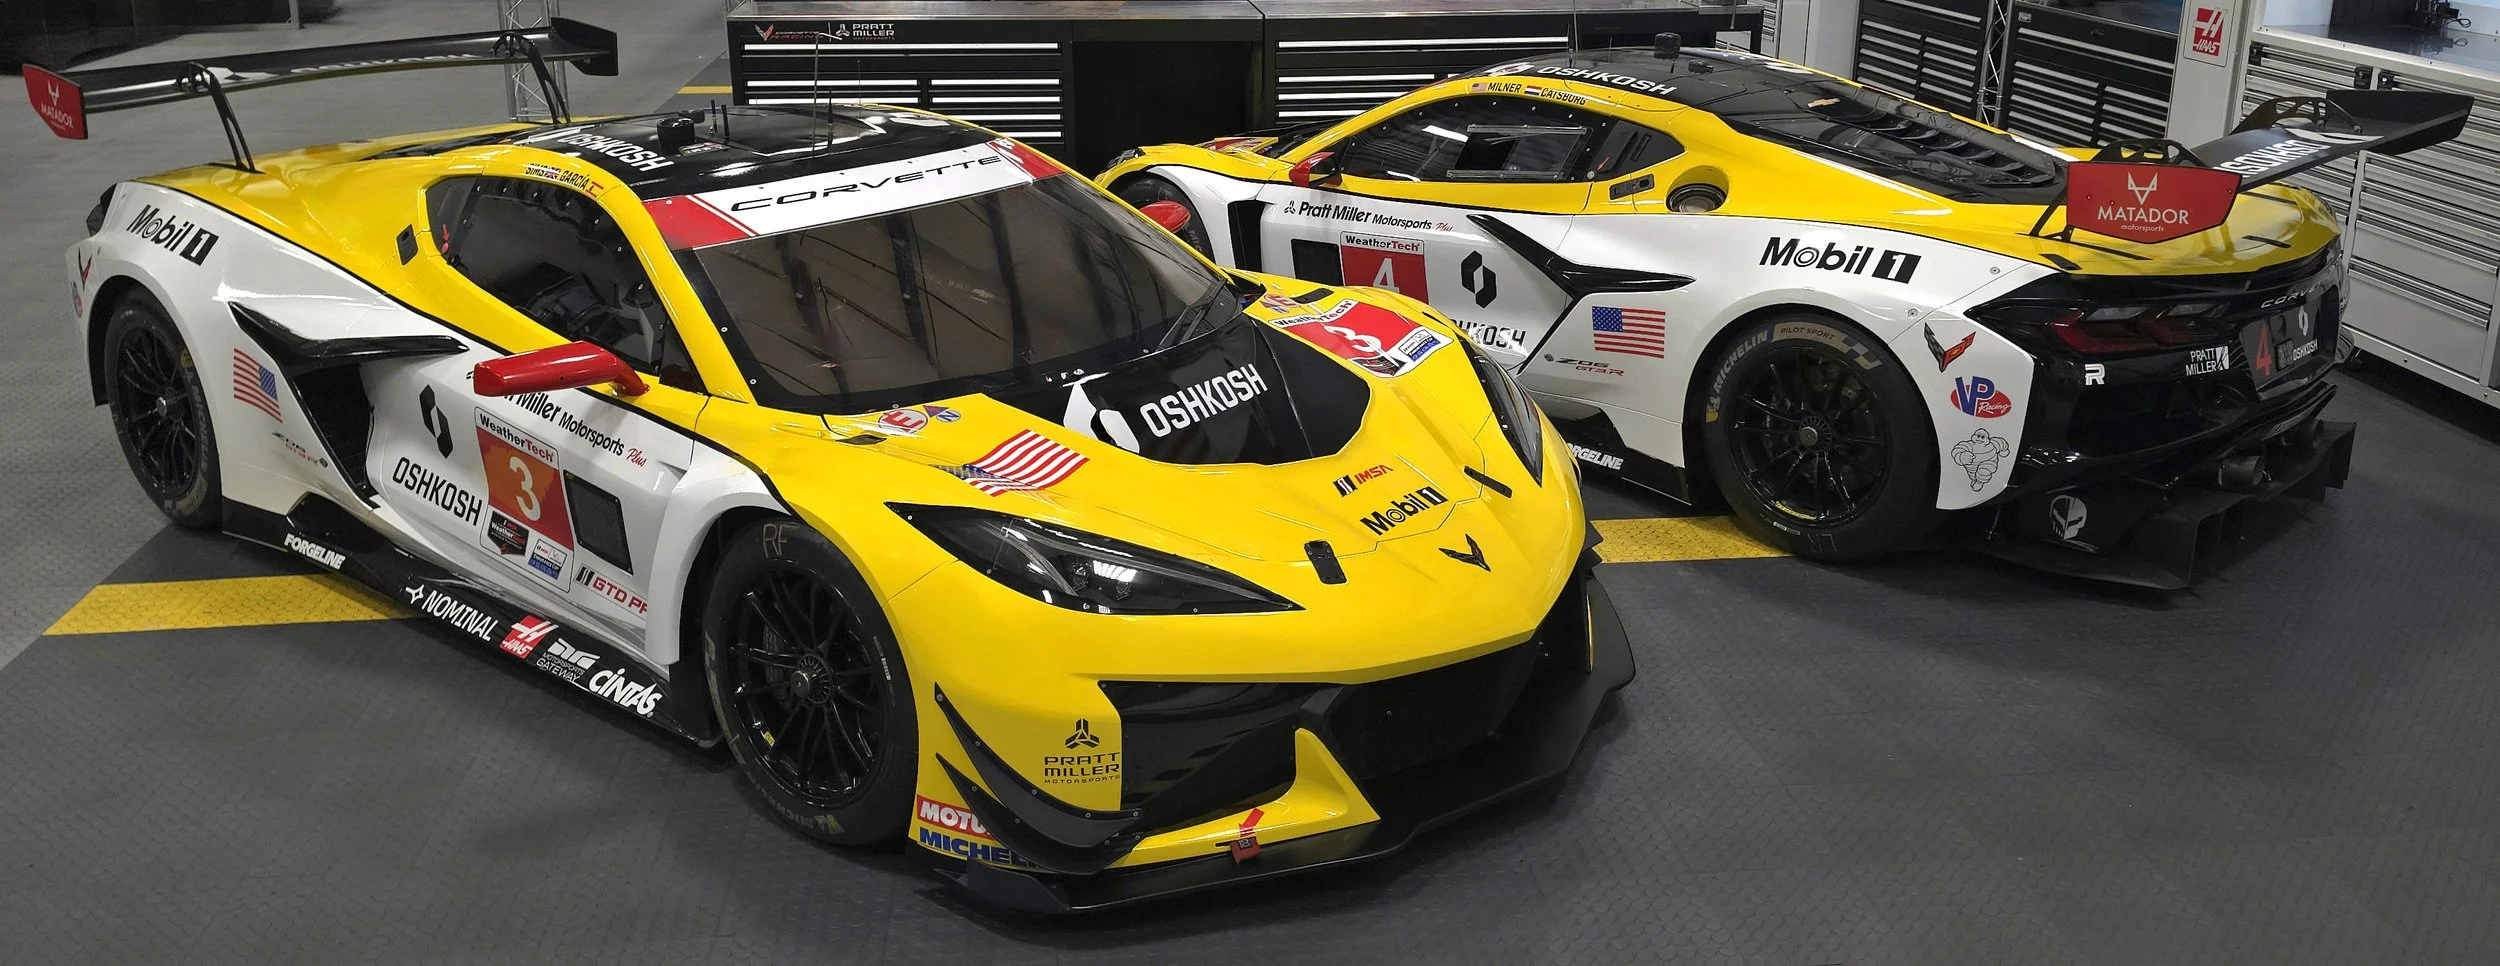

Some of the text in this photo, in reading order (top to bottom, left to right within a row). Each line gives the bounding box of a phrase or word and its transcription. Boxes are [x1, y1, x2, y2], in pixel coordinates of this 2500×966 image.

[2192, 38, 2221, 53] HAAS
[1487, 82, 1586, 105] MILNER CATSBURG
[1536, 66, 1677, 95] OSHKOSH
[41, 102, 74, 129] MATADOR
[557, 133, 675, 172] OSHKOSH
[559, 170, 590, 191] GARCÍA
[730, 154, 1001, 213] CORVETTE
[126, 204, 195, 252] Mobil
[1299, 201, 1453, 232] Pratt Miller Motorsports Plus
[2098, 206, 2189, 225] MATADOR
[2121, 223, 2164, 232] motorsports
[1345, 235, 1421, 252] WeatherTech
[1759, 236, 1875, 275] Mobil
[1372, 257, 1400, 294] 4
[1323, 324, 1382, 353] 3
[2256, 326, 2273, 378] 4
[1556, 357, 1610, 369] Z06
[1714, 327, 1836, 394] MICHELIN PILOT SPORT
[2185, 361, 2217, 376] MILLER
[2190, 349, 2216, 363] PRATT
[1140, 363, 1269, 438] OSHKOSH
[1954, 375, 1996, 418] VP
[1978, 401, 2013, 416] Racing
[479, 413, 554, 462] WeatherTech
[558, 412, 625, 456] Motorsports
[626, 447, 648, 467] Plus
[509, 456, 541, 522] 3
[1354, 464, 1395, 485] IMSA
[392, 456, 483, 527] OSHKOSH
[1360, 493, 1430, 536] Mobil
[284, 533, 346, 570] FORGELINE
[762, 523, 801, 559] RF
[592, 576, 628, 604] GTD
[422, 590, 499, 642] NOMINAL
[502, 638, 534, 657] HAAS
[536, 657, 581, 684] GATEWAY
[541, 652, 586, 676] MOTORSPORTS
[1044, 752, 1120, 766] PRATT
[1044, 763, 1120, 777] MILLER
[1044, 775, 1120, 784] MOTORSPORTS
[919, 800, 988, 834] MOTU
